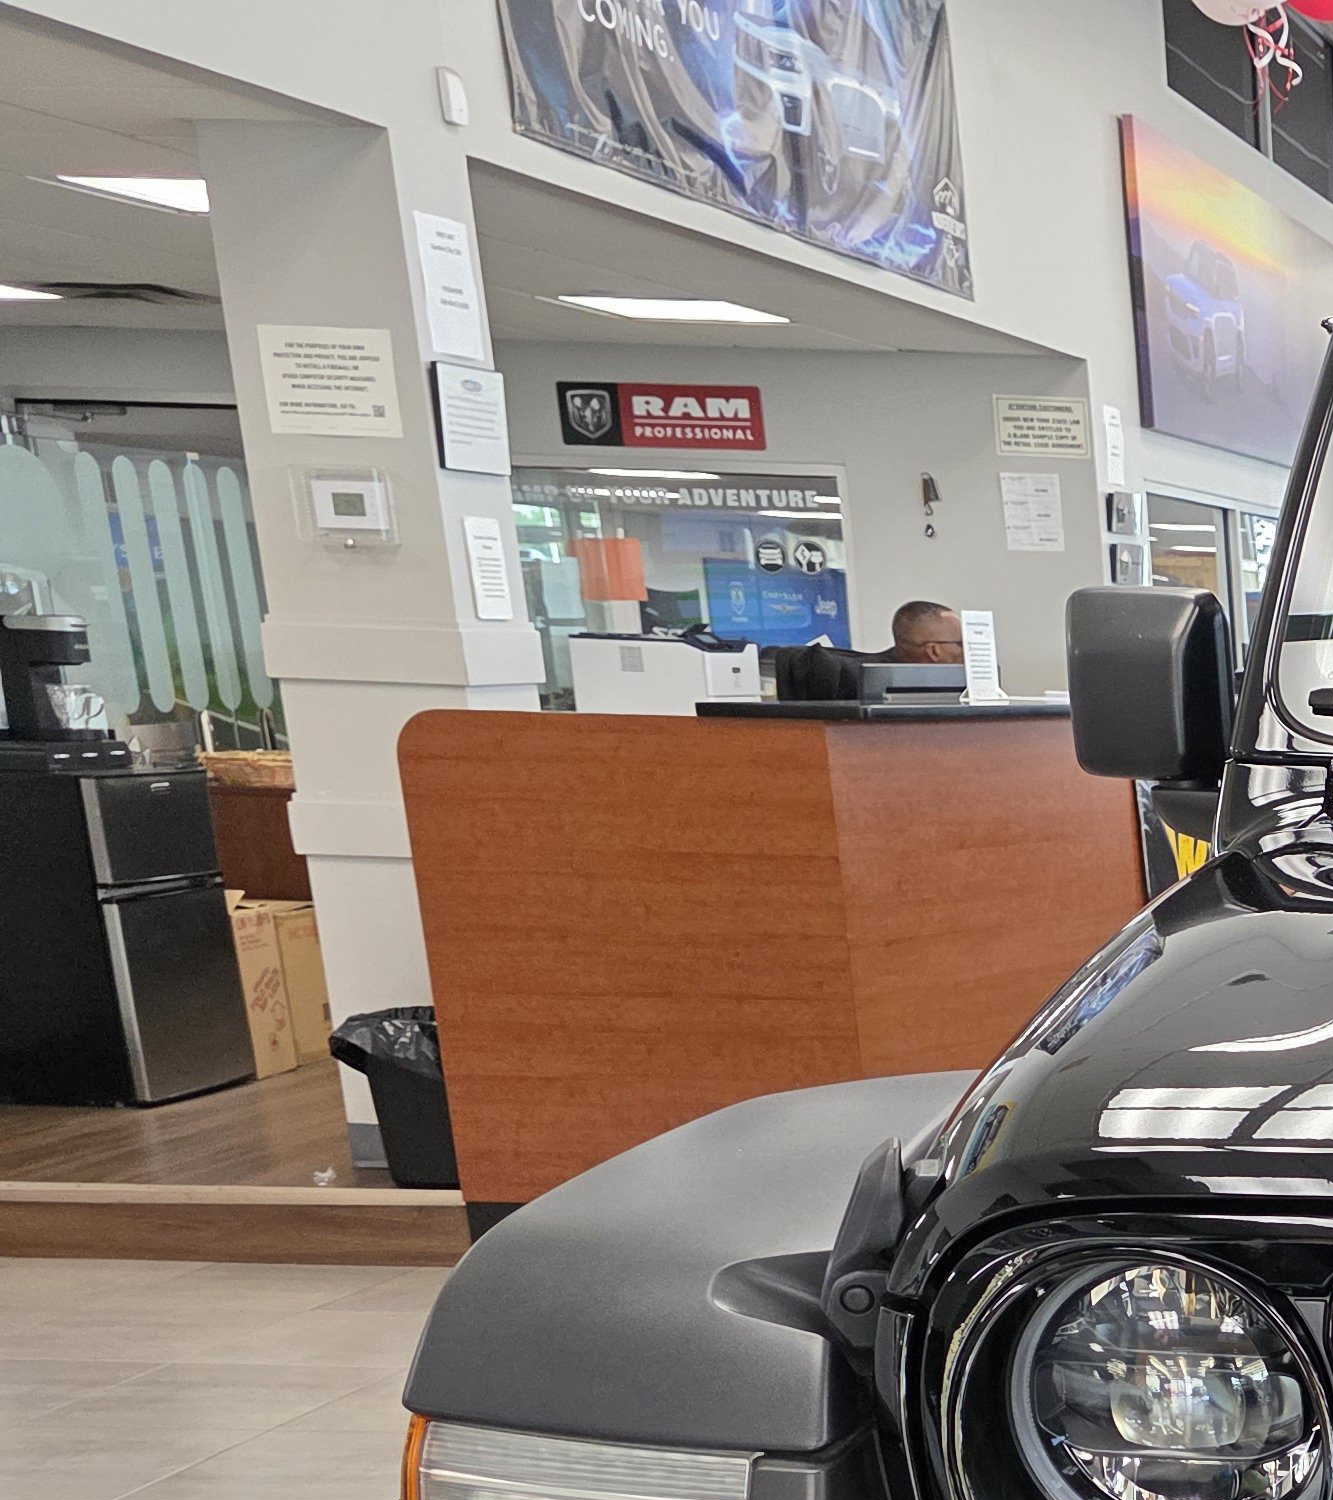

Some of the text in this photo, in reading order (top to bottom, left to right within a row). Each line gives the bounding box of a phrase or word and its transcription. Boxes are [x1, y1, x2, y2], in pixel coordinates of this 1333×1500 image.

[577, 0, 674, 62] COMING.
[677, 0, 720, 41] YOU
[631, 395, 751, 418] RAM
[634, 426, 754, 440] PROFESSIONAL
[677, 487, 817, 508] ADVENTURE
